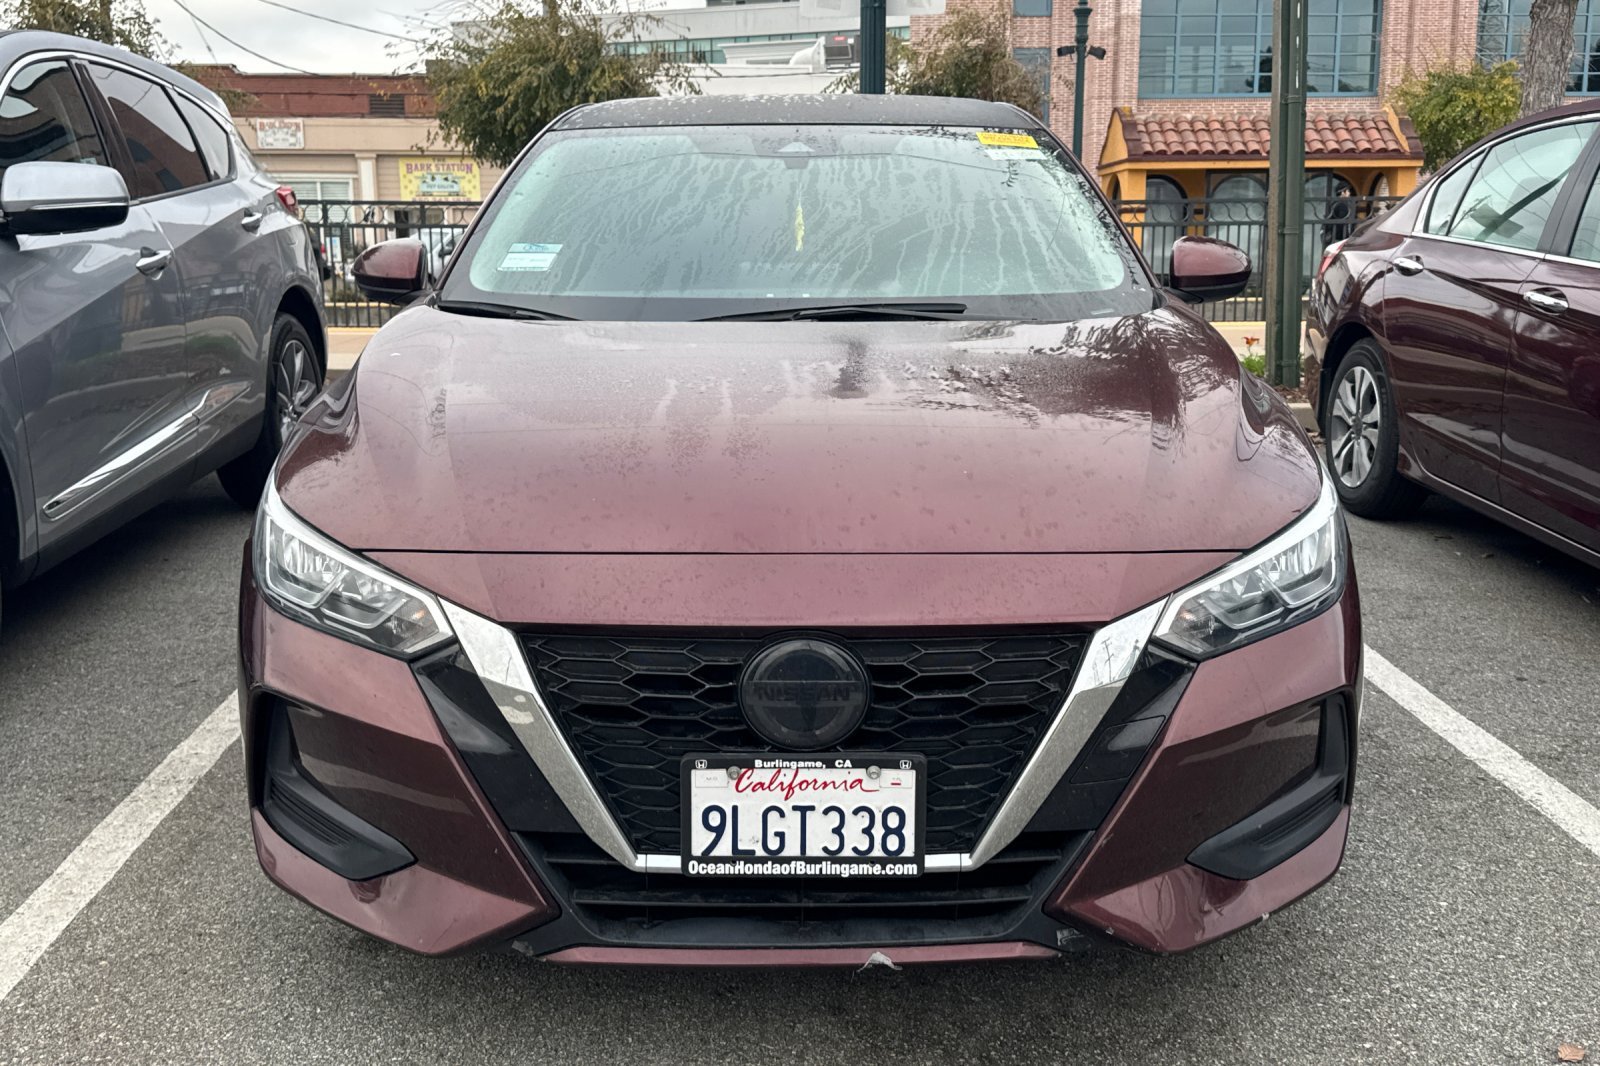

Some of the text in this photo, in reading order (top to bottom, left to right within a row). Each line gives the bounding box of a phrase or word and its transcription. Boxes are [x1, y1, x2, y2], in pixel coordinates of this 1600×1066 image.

[406, 163, 473, 174] BARK STATION
[754, 759, 853, 770] Burlingame, CA
[735, 768, 880, 801] California
[701, 804, 906, 857] 9LGT338
[688, 860, 917, 877] OceanHondaofBurlingame.com
